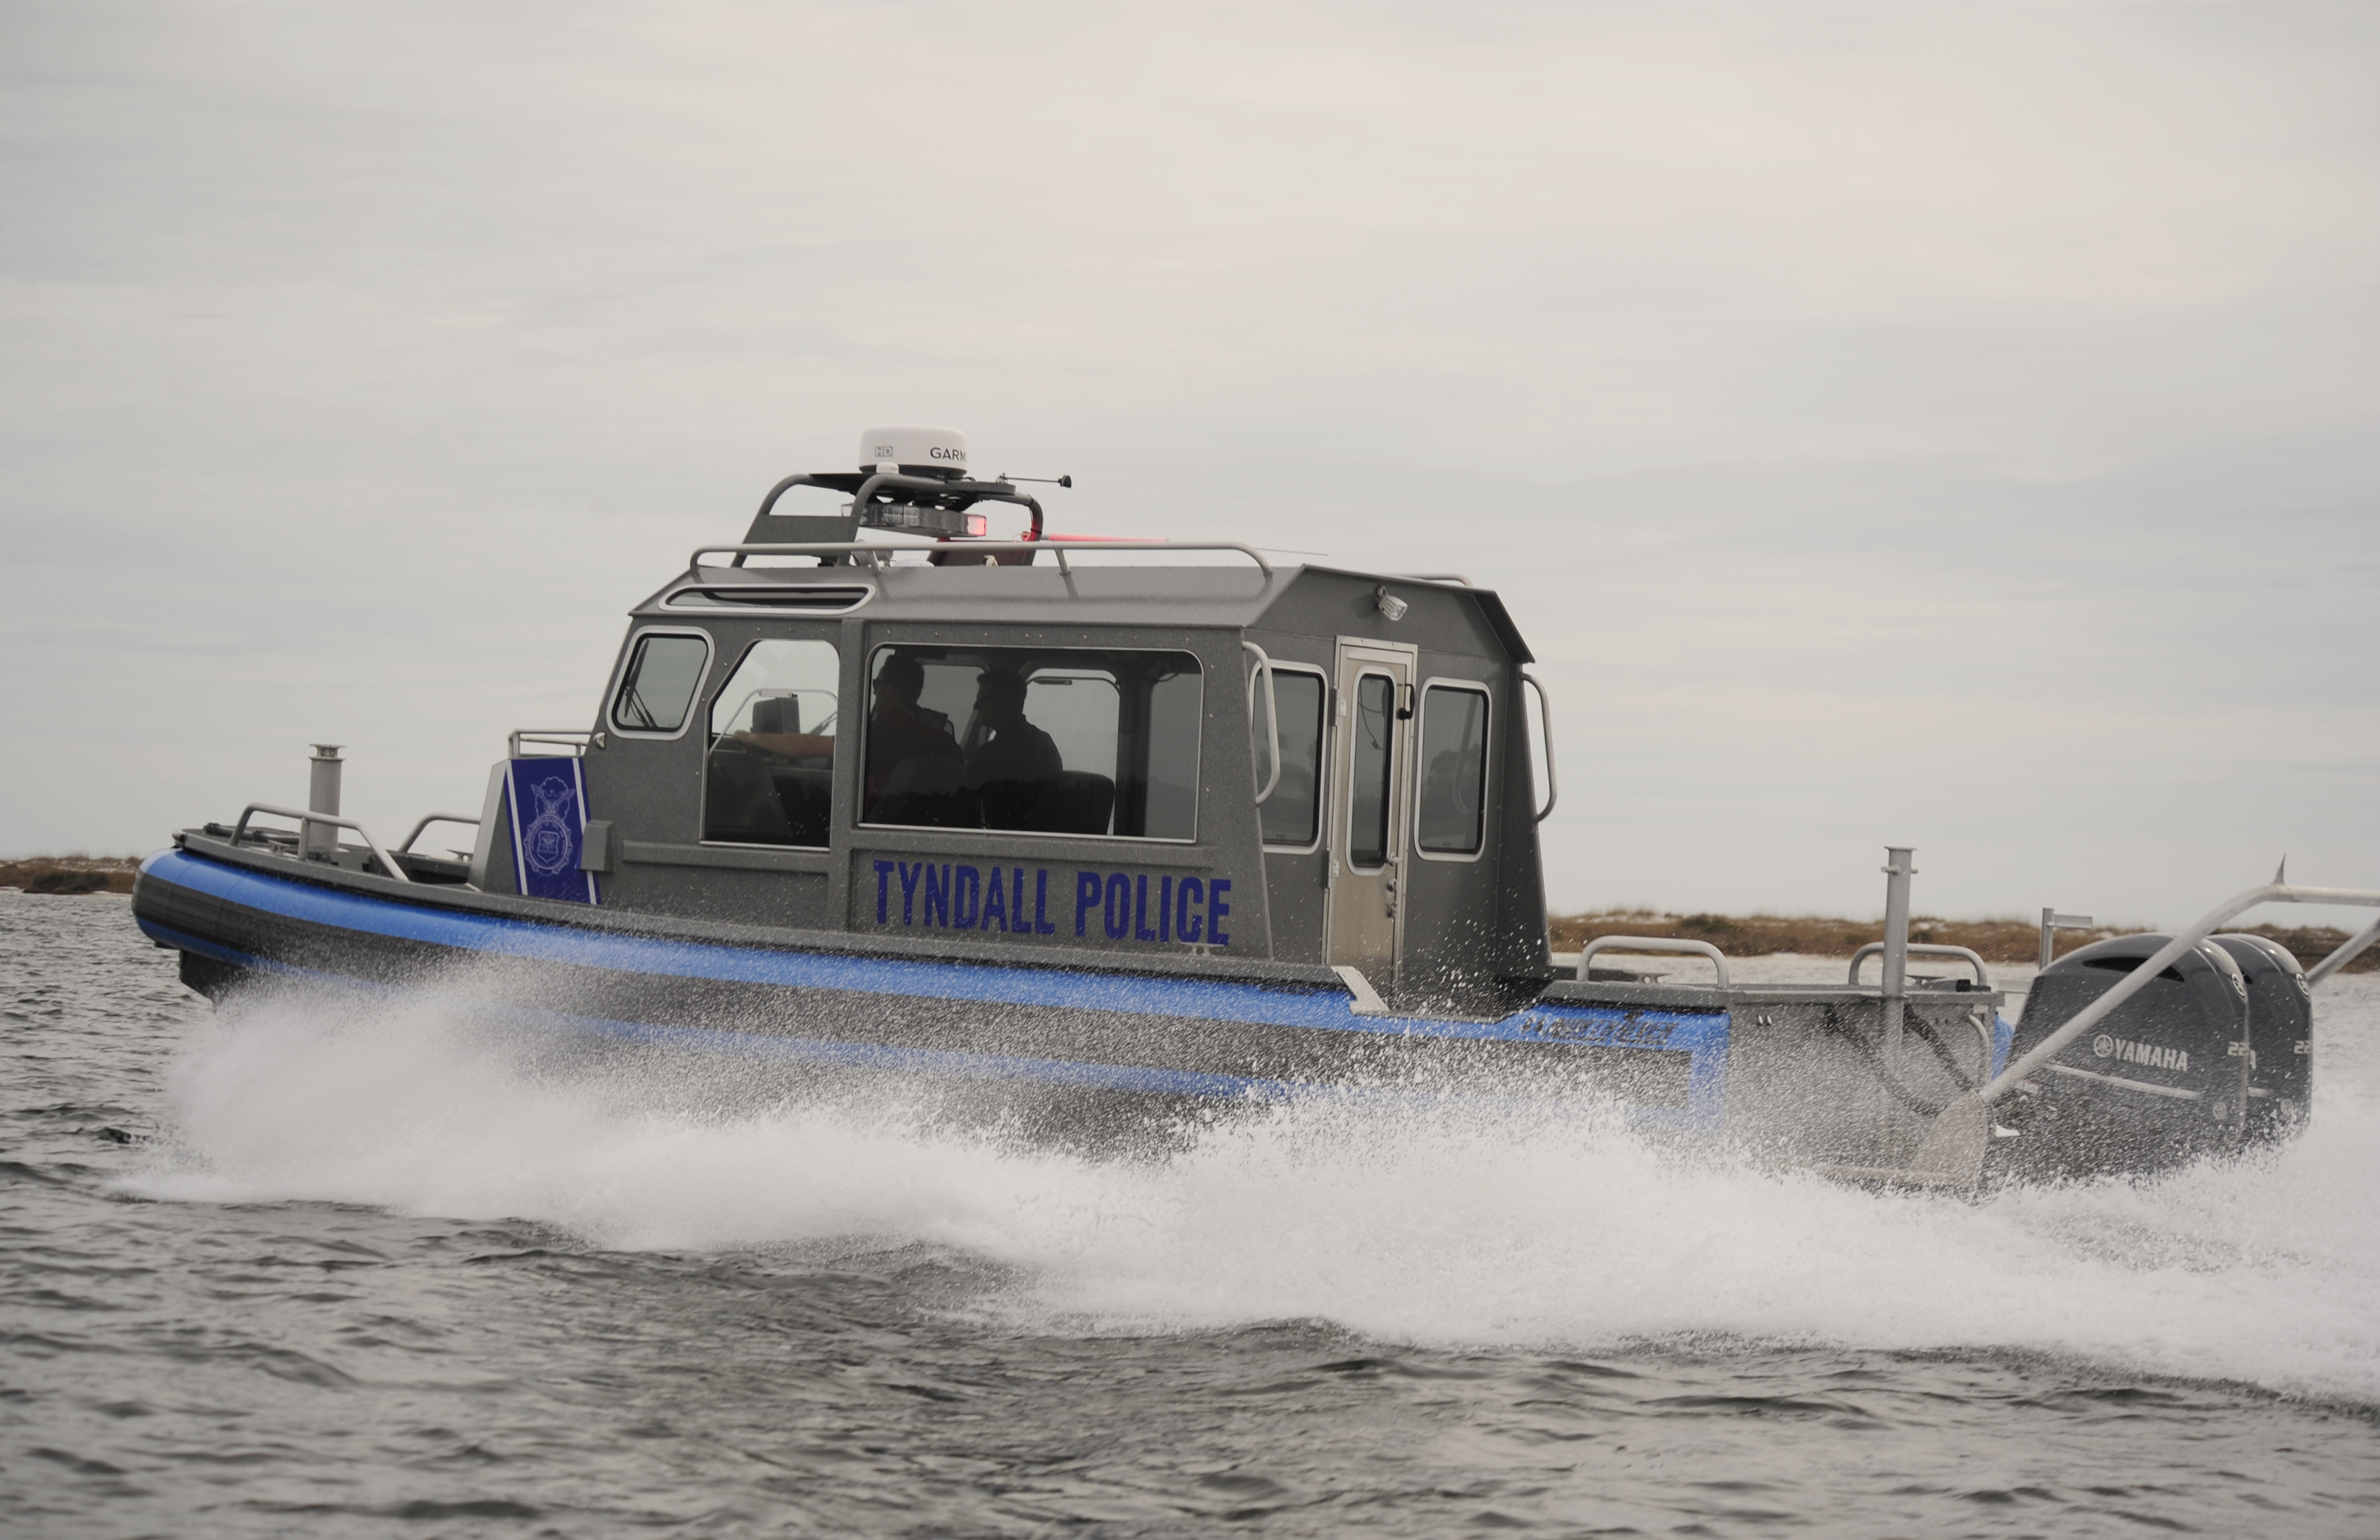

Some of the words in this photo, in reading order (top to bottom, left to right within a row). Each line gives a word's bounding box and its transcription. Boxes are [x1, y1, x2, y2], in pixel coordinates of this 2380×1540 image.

[875, 446, 893, 457] HD
[930, 447, 967, 462] GARM
[874, 860, 1056, 935] TYNDALL
[1075, 870, 1231, 946] POLICE
[2115, 1038, 2188, 1072] YAMAHA
